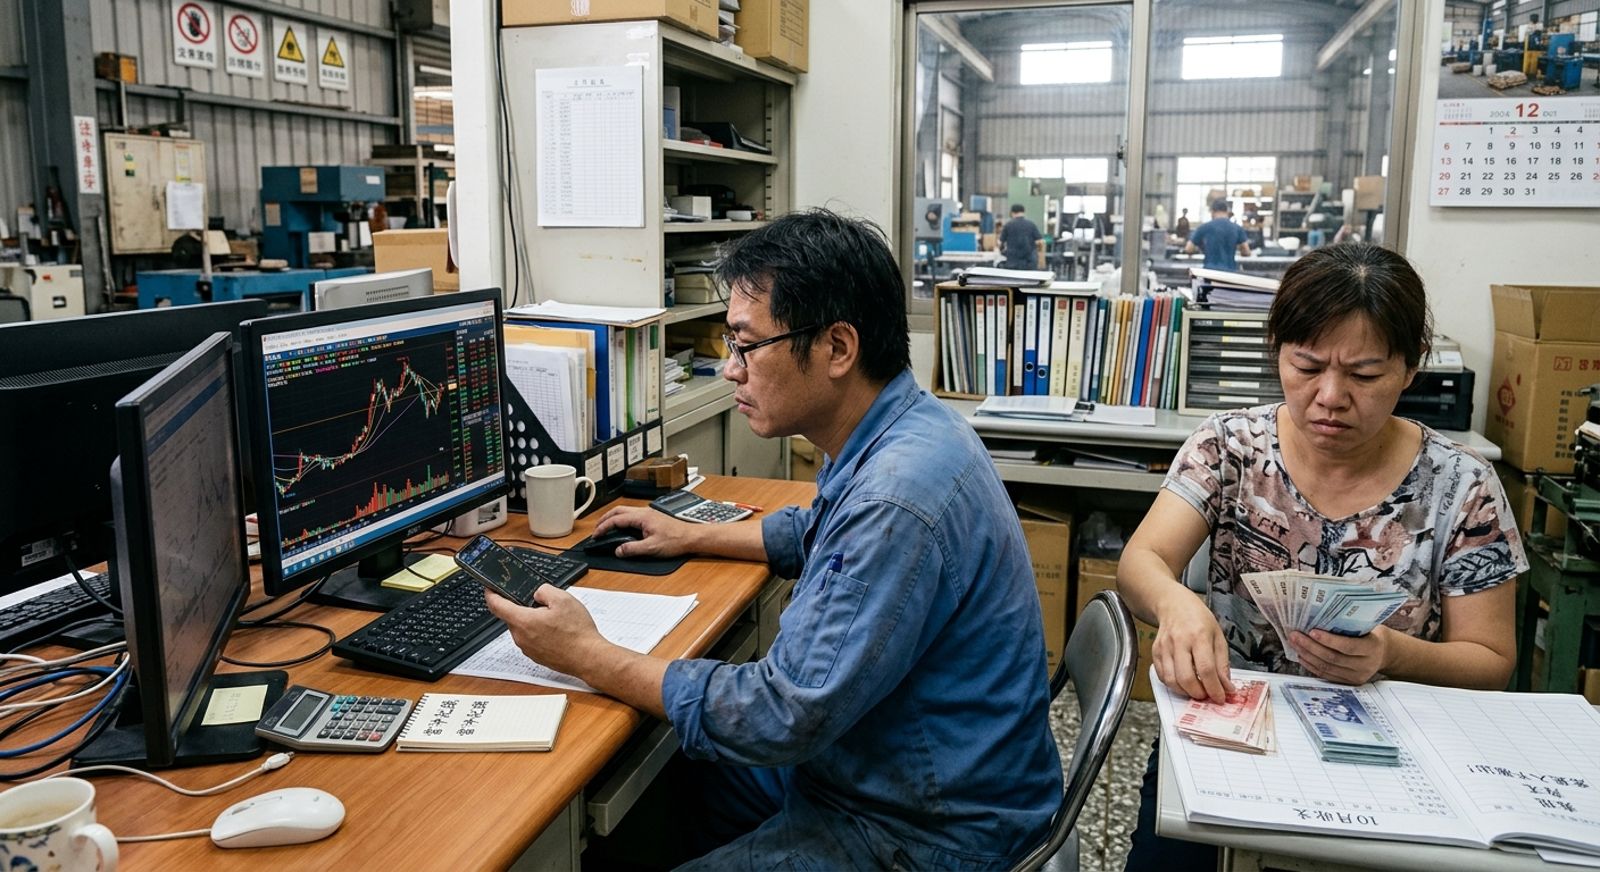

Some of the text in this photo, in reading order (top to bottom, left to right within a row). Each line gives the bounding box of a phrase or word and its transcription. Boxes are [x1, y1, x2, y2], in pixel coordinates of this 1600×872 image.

[1515, 103, 1540, 118] 12
[1531, 126, 1539, 135] 3
[1554, 126, 1561, 135] 4
[1576, 126, 1584, 134] 4
[1508, 142, 1516, 151] 9
[1573, 141, 1584, 150] 11
[1440, 157, 1452, 166] 13
[1462, 156, 1474, 166] 14
[1484, 157, 1495, 166] 15
[1505, 157, 1517, 166] 16
[1527, 157, 1540, 166] 17
[1550, 157, 1562, 166] 18
[1572, 157, 1584, 166] 18
[1460, 172, 1472, 181] 21
[1482, 172, 1494, 181] 22
[1503, 172, 1516, 181] 23
[1526, 172, 1538, 181] 24
[1548, 172, 1560, 181] 25
[1570, 172, 1583, 181] 26
[1438, 187, 1536, 196] 27 28 29 30 31
